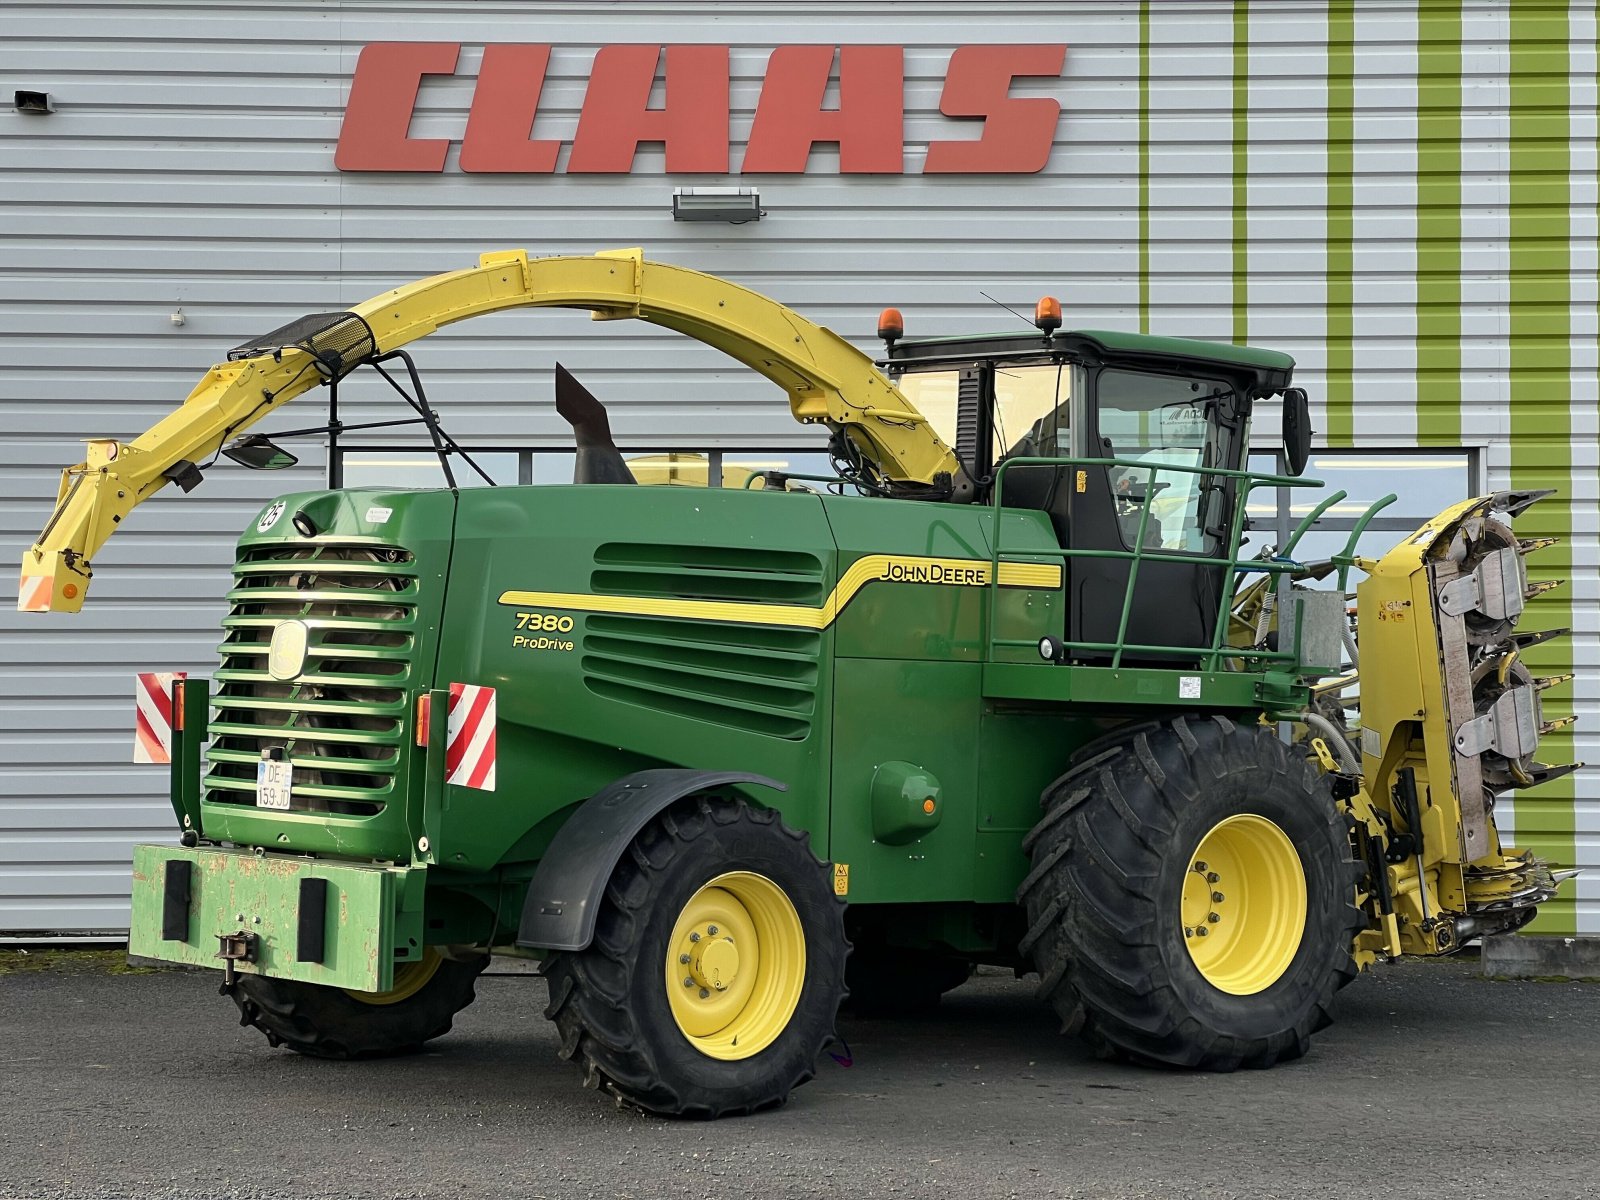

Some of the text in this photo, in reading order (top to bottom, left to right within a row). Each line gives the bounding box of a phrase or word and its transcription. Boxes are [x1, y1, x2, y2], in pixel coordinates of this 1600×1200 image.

[333, 42, 1067, 174] CLAAS
[260, 503, 284, 527] 25
[881, 561, 986, 584] JOHN DEERE
[514, 612, 574, 633] 7380
[512, 634, 574, 651] ProDrive
